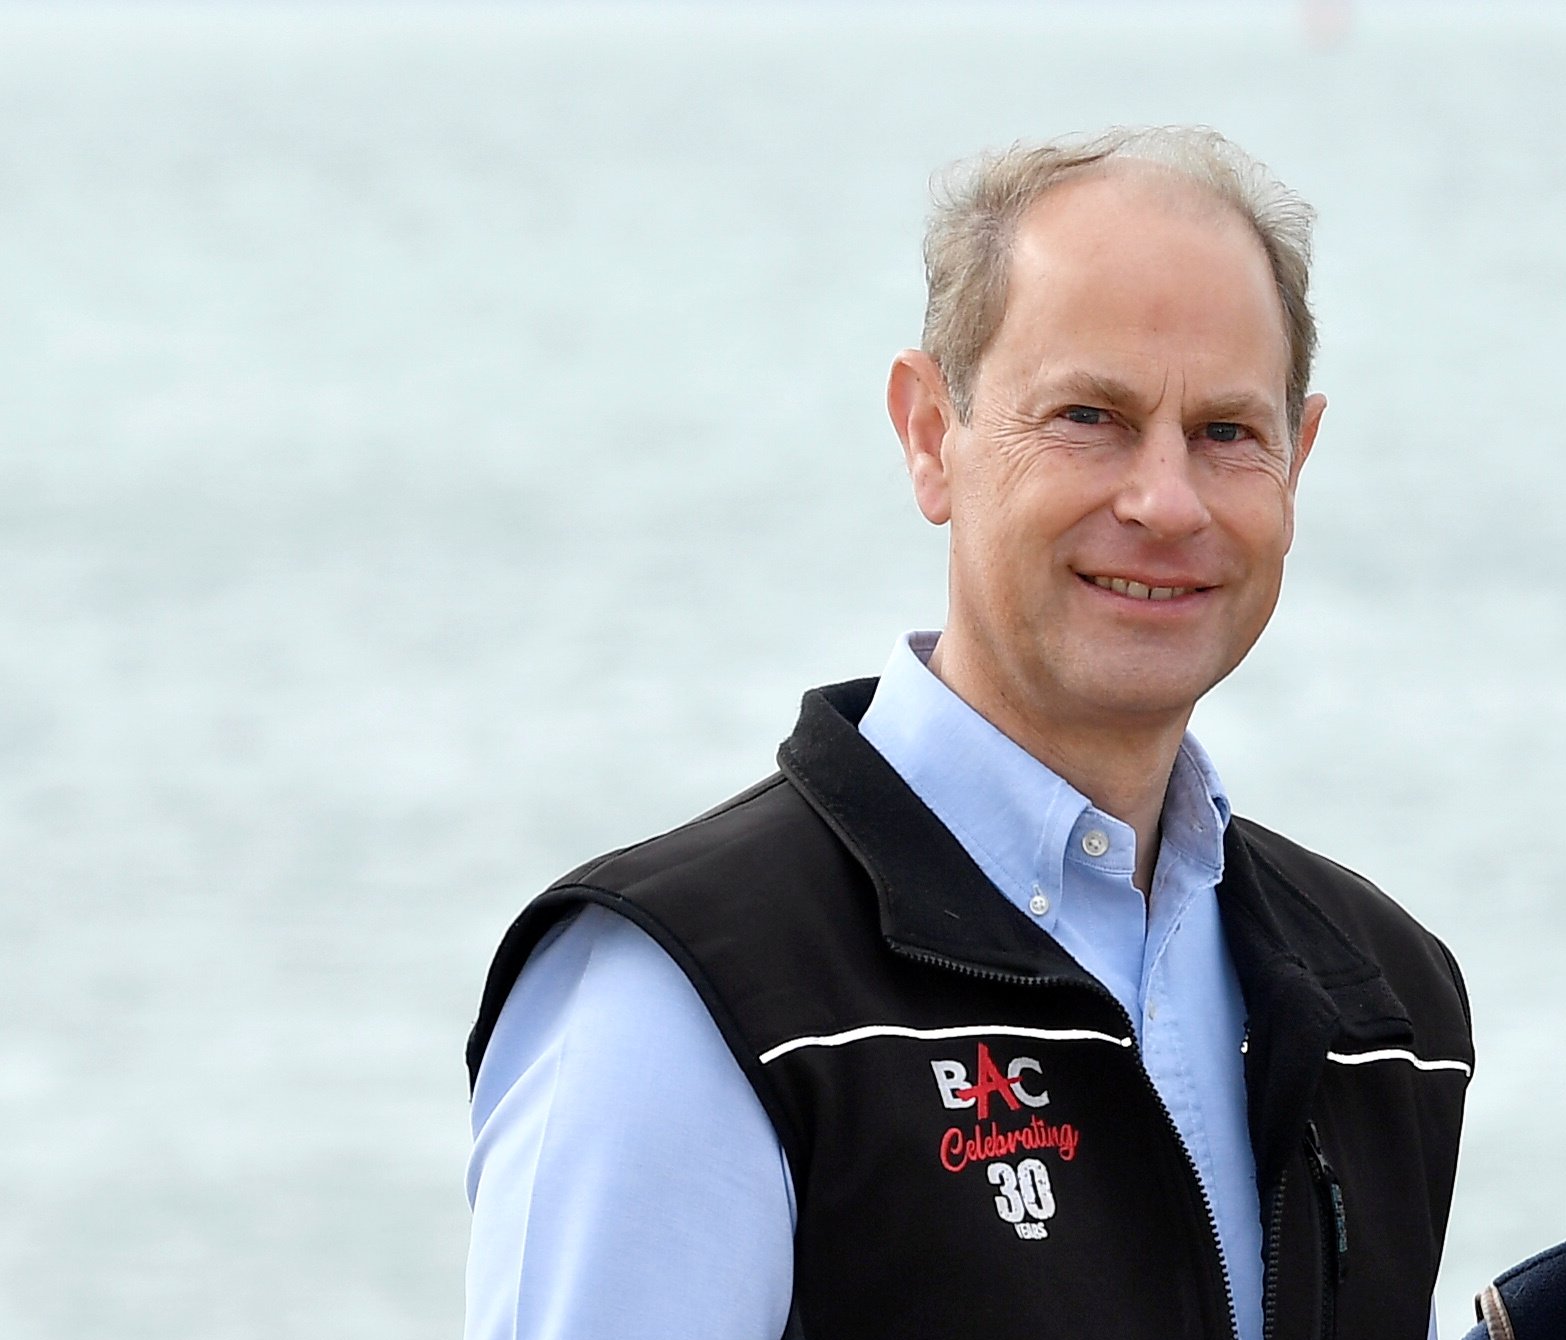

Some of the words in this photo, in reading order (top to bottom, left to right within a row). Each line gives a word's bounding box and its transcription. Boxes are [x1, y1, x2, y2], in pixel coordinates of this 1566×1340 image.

[930, 1041, 1050, 1120] BAC
[940, 1115, 1080, 1173] Celebrating
[987, 1158, 1056, 1223] 30
